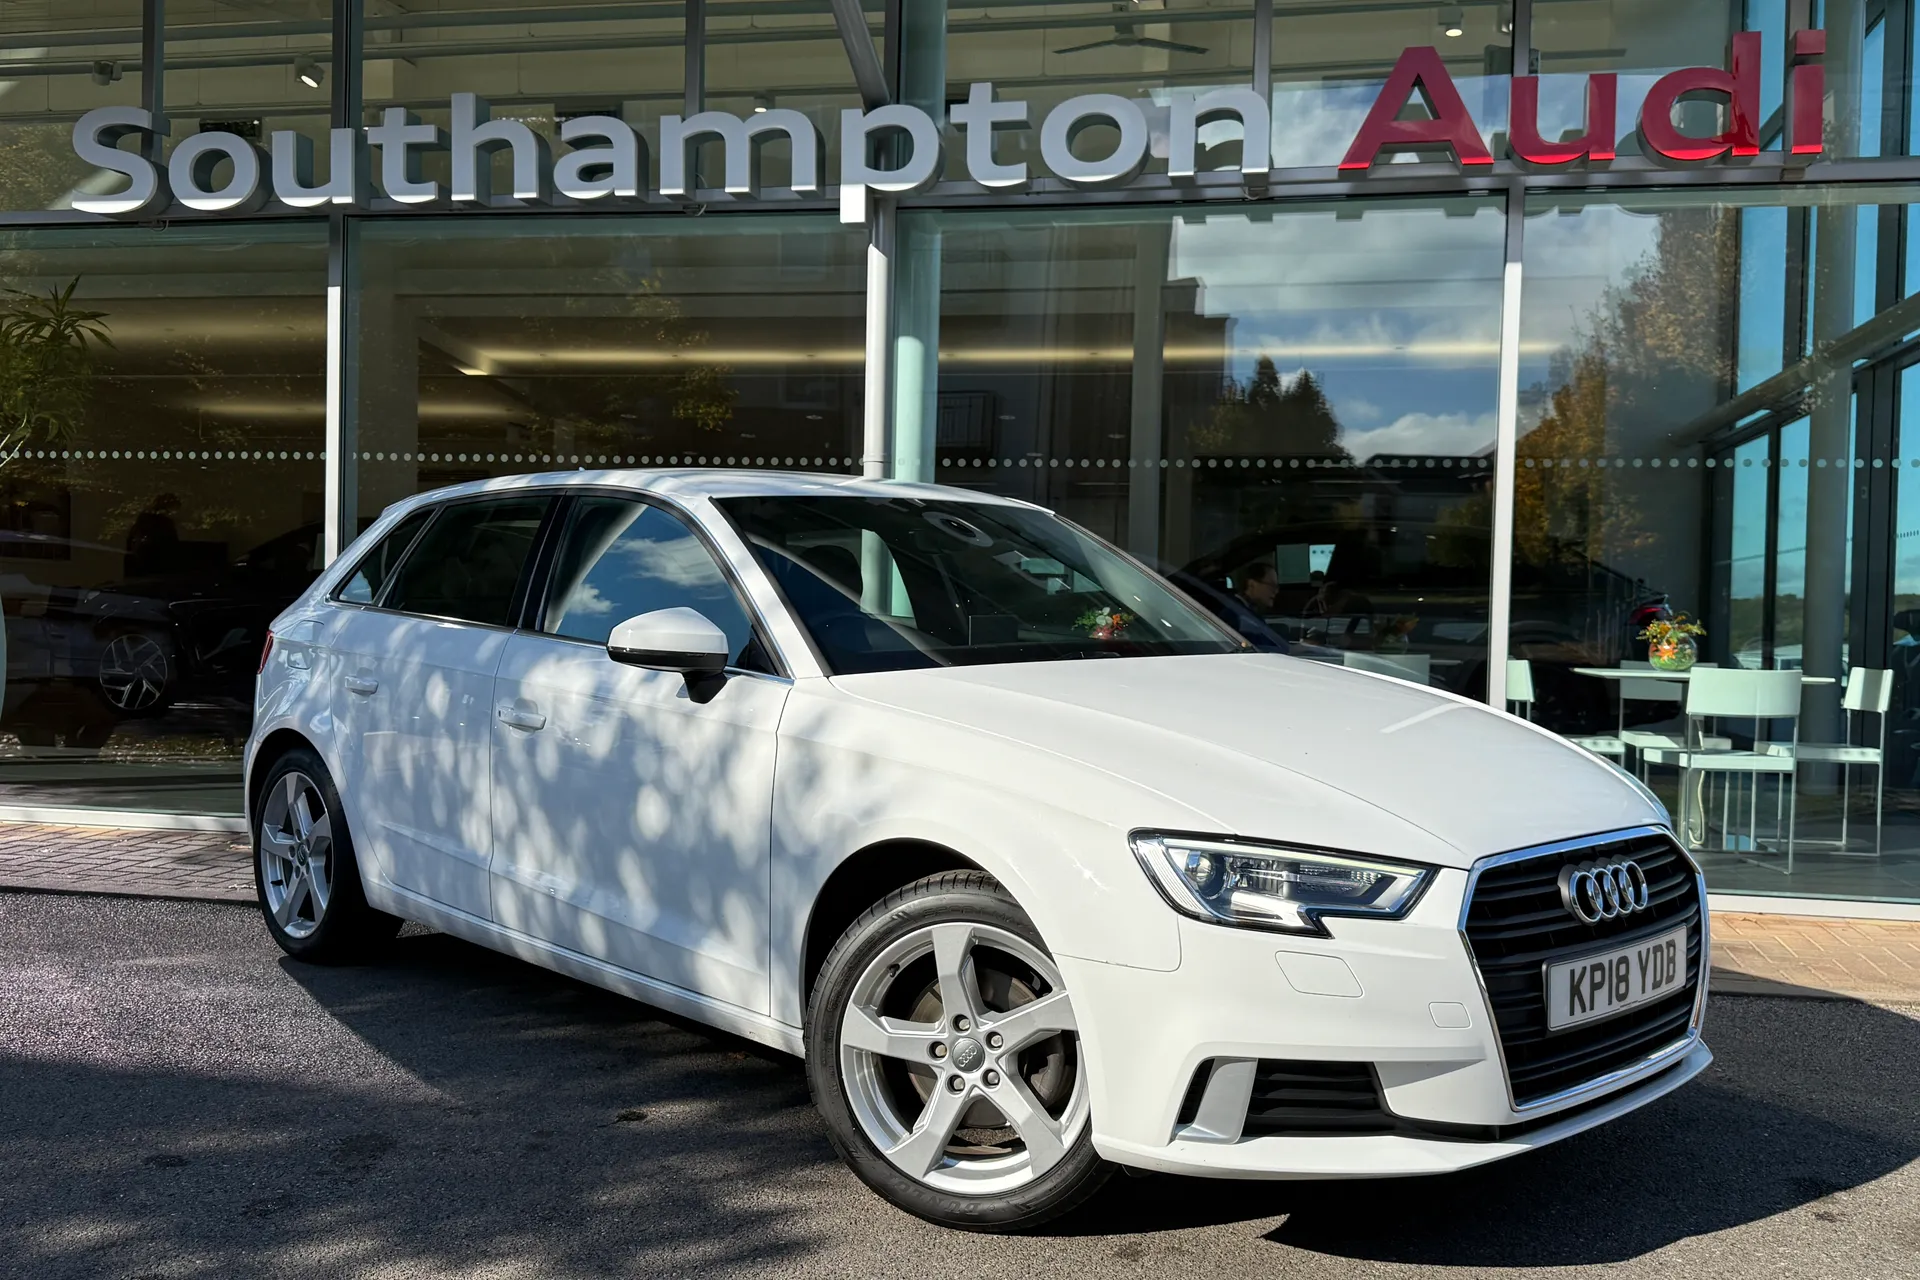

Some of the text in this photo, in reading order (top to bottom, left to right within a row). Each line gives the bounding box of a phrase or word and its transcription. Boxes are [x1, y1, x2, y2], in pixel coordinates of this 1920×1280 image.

[71, 30, 1826, 224] Southampton Audi
[1569, 939, 1676, 1016] KP18 YDB
